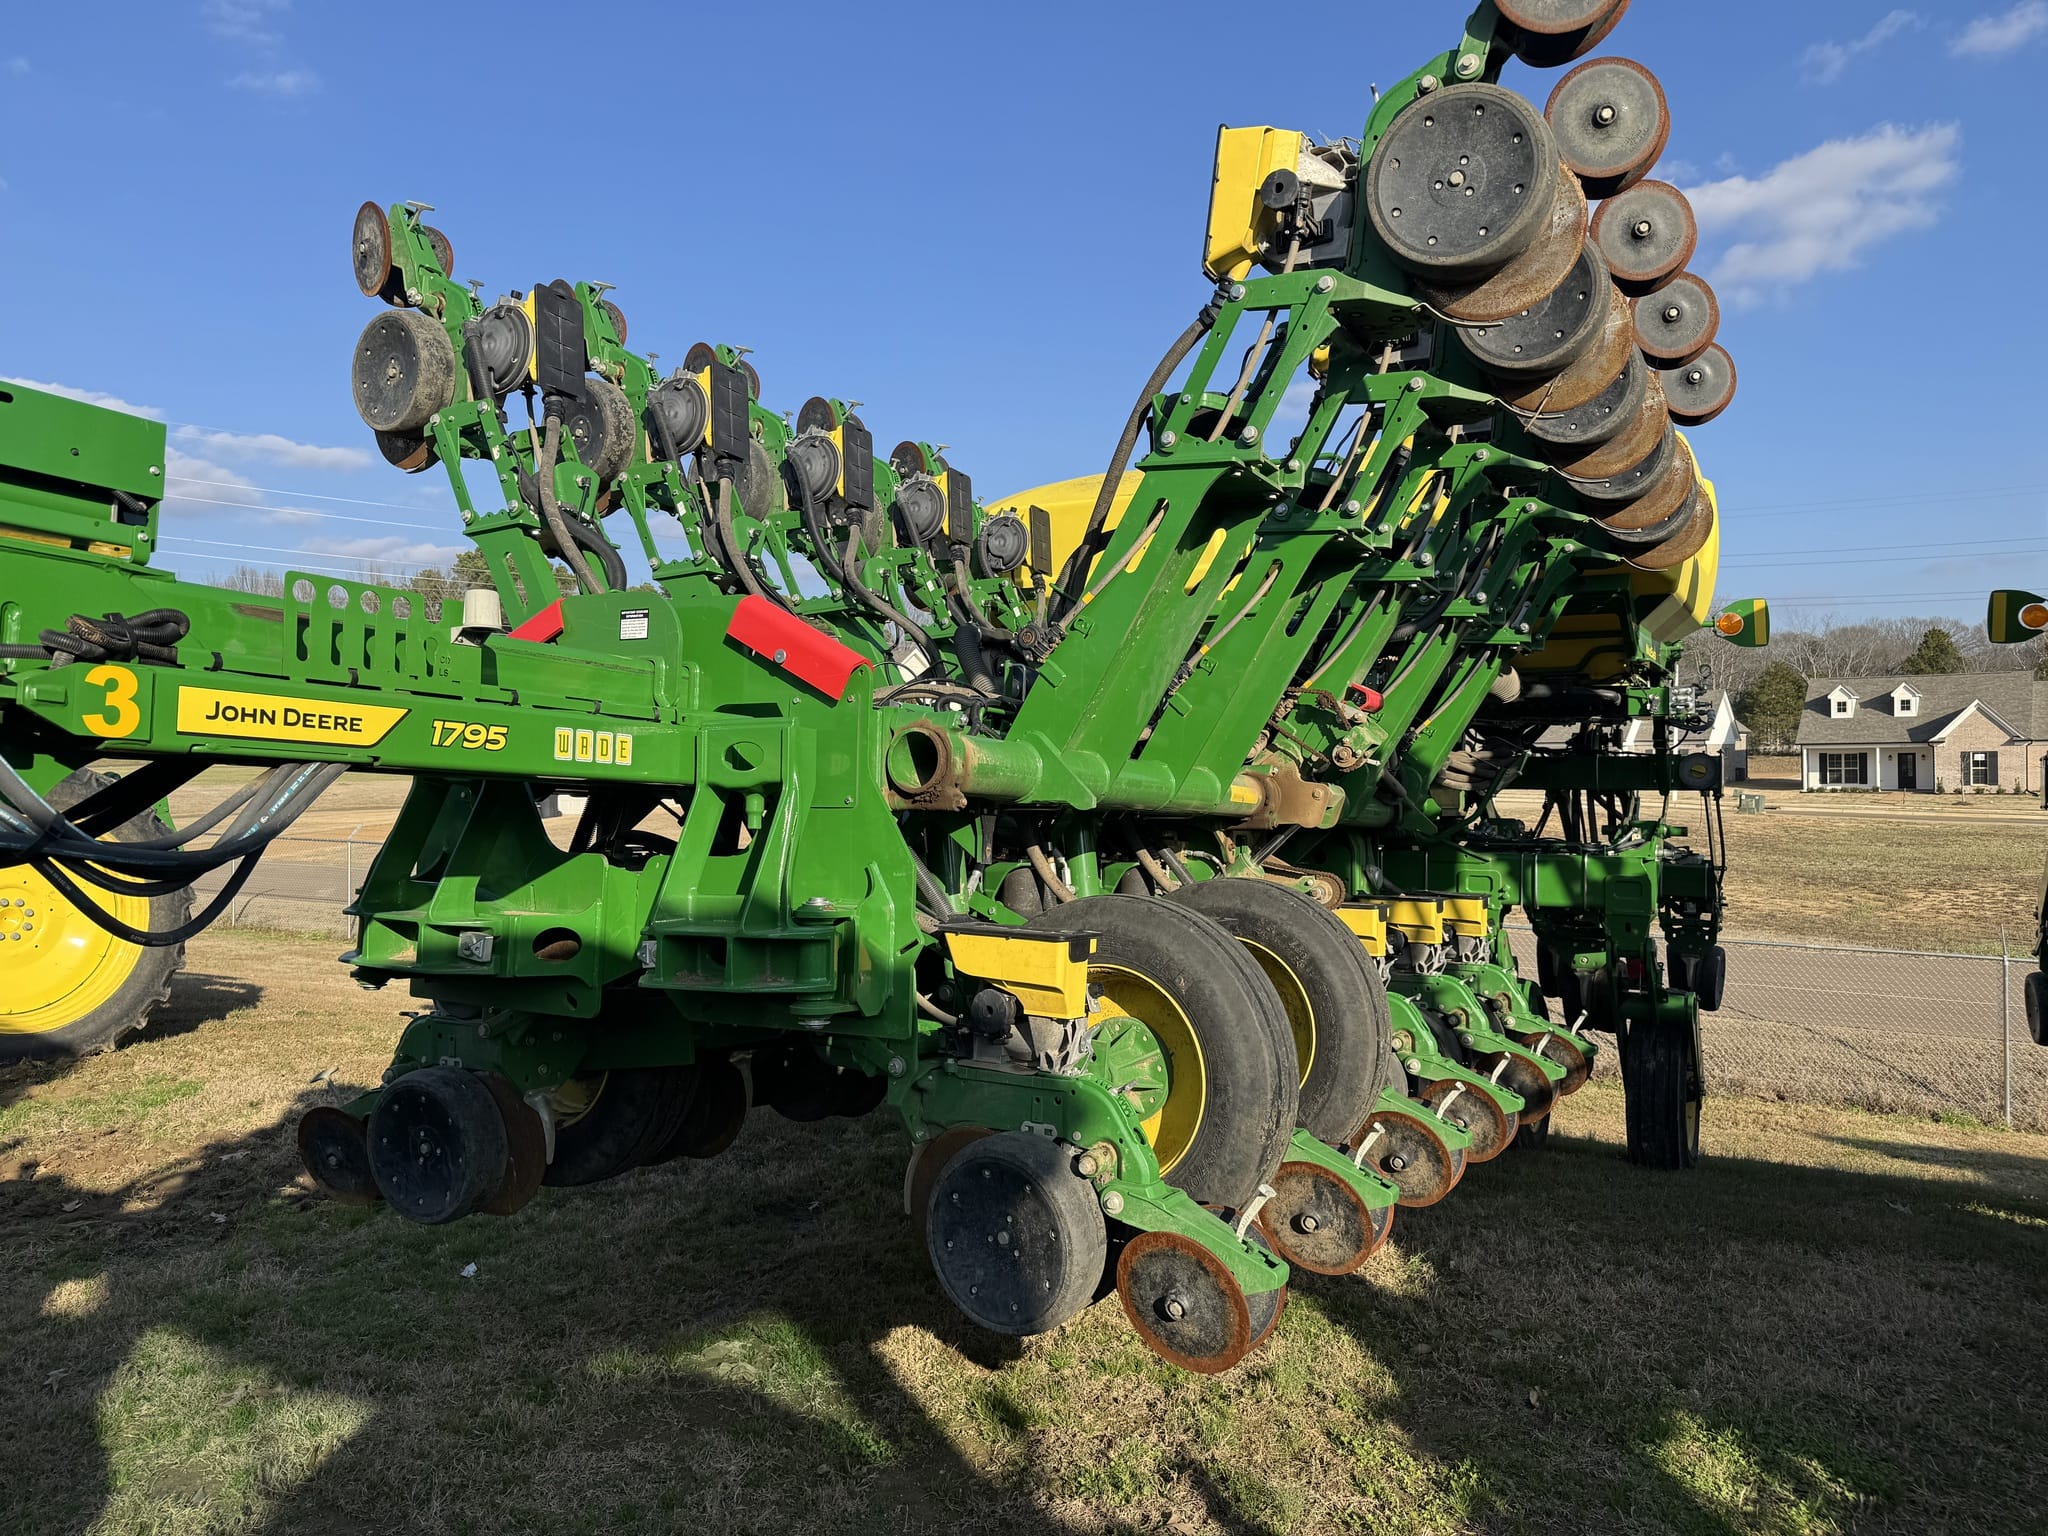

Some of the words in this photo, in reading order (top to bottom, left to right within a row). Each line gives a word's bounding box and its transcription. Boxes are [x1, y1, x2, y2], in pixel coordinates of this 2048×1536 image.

[82, 664, 141, 738] 3
[205, 700, 277, 726] JOHN
[283, 707, 363, 733] DEERE
[431, 718, 510, 751] 1795
[557, 731, 630, 761] WADE
